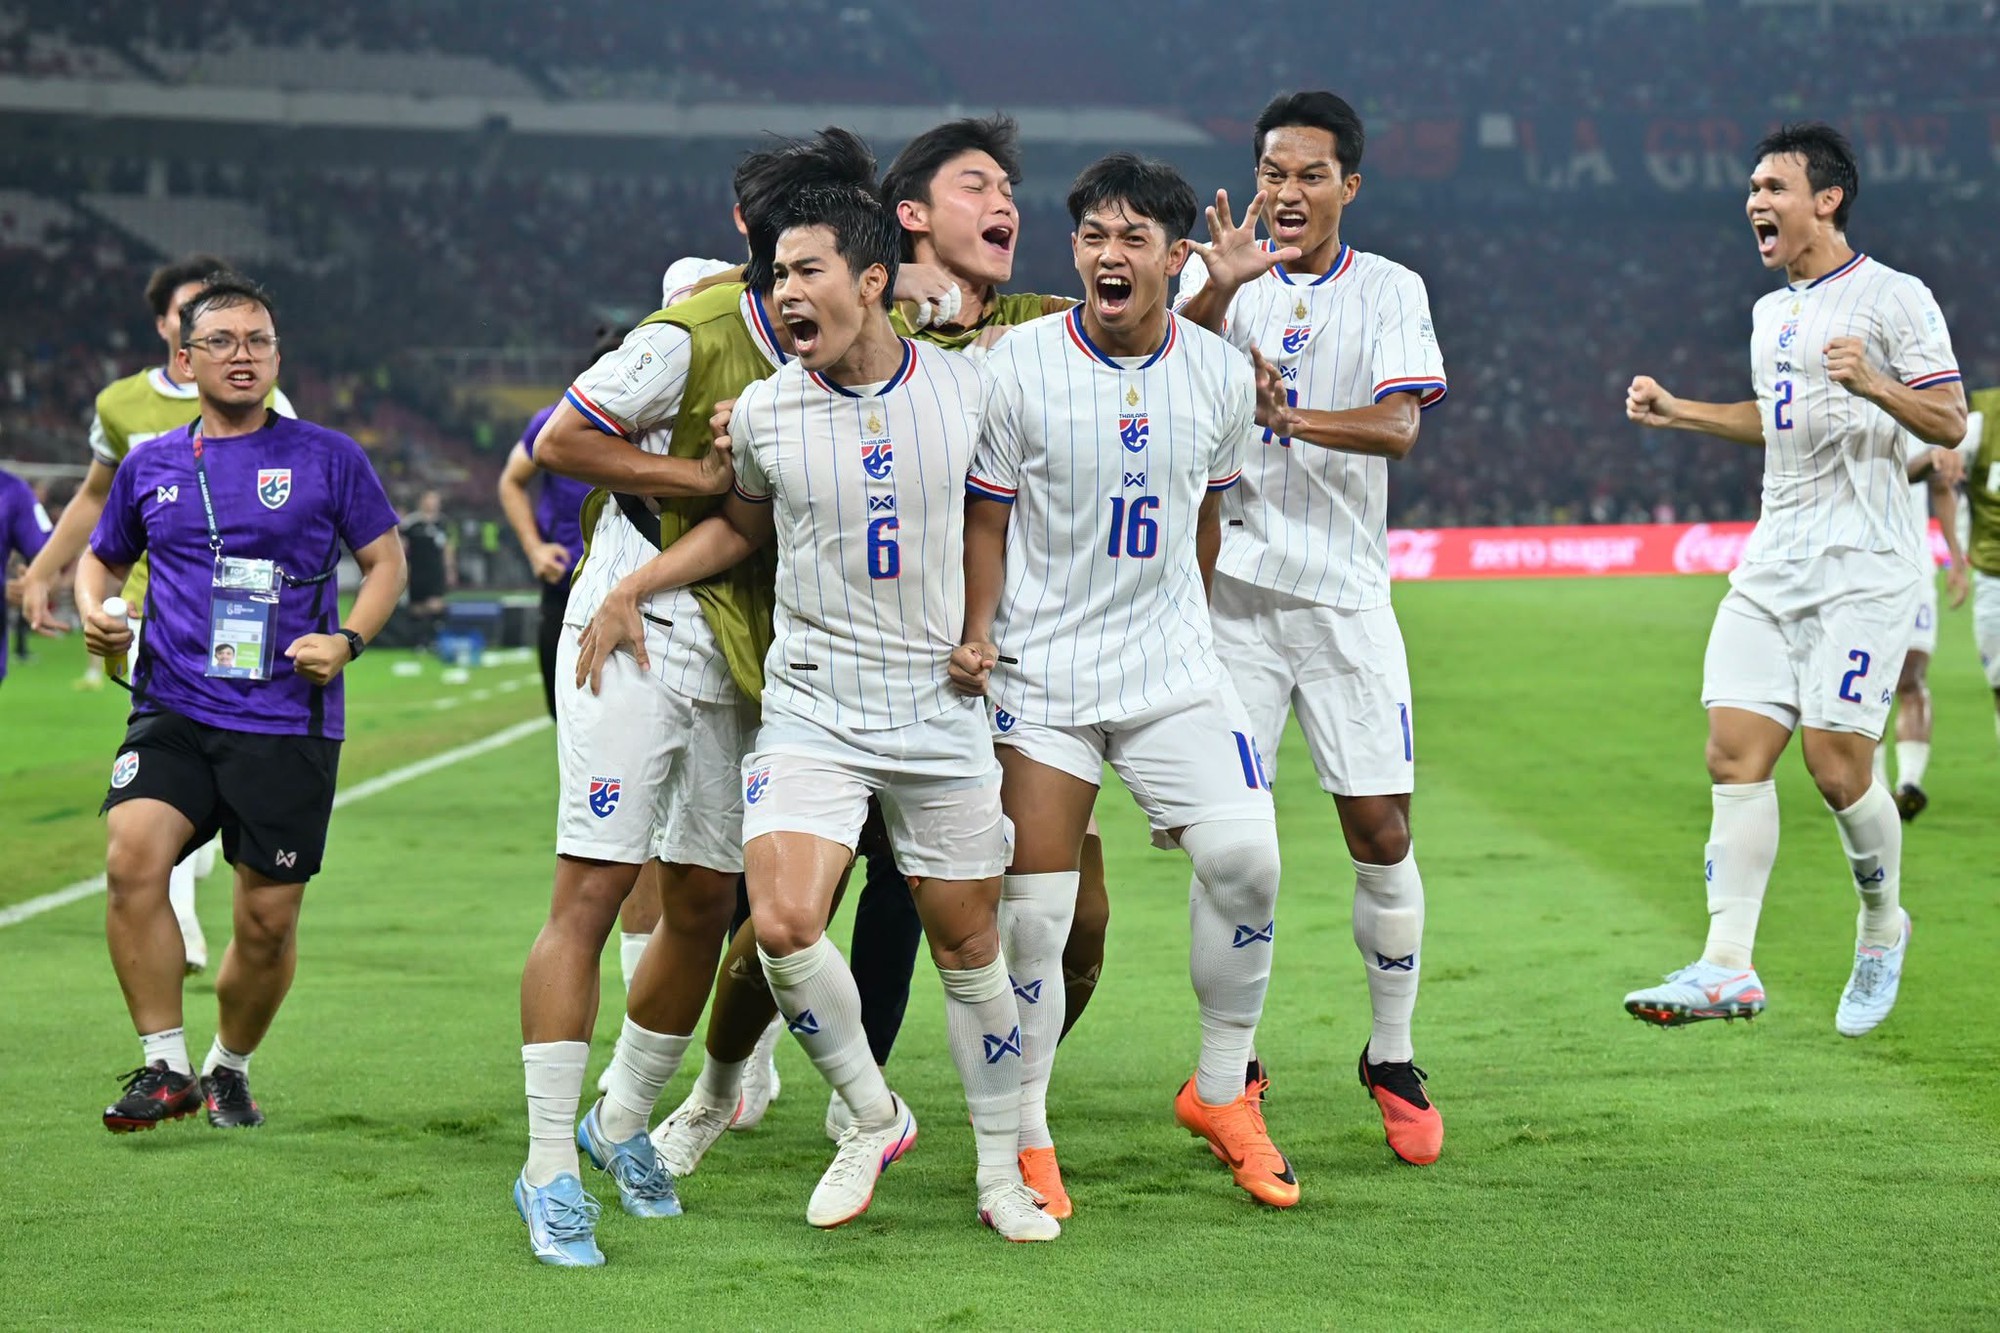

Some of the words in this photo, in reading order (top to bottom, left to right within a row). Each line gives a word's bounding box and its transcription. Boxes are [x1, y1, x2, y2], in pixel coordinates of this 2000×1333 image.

[1517, 115, 1615, 192] LA
[1645, 113, 1960, 191] GRDE
[1775, 380, 1793, 430] 2
[860, 438, 892, 446] THAILAND
[867, 516, 902, 580] 6
[1107, 495, 1160, 559] 16
[1469, 538, 1546, 570] zero
[1550, 536, 1643, 573] sugar
[1838, 649, 1870, 704] 2
[591, 776, 621, 784] THAILAND
